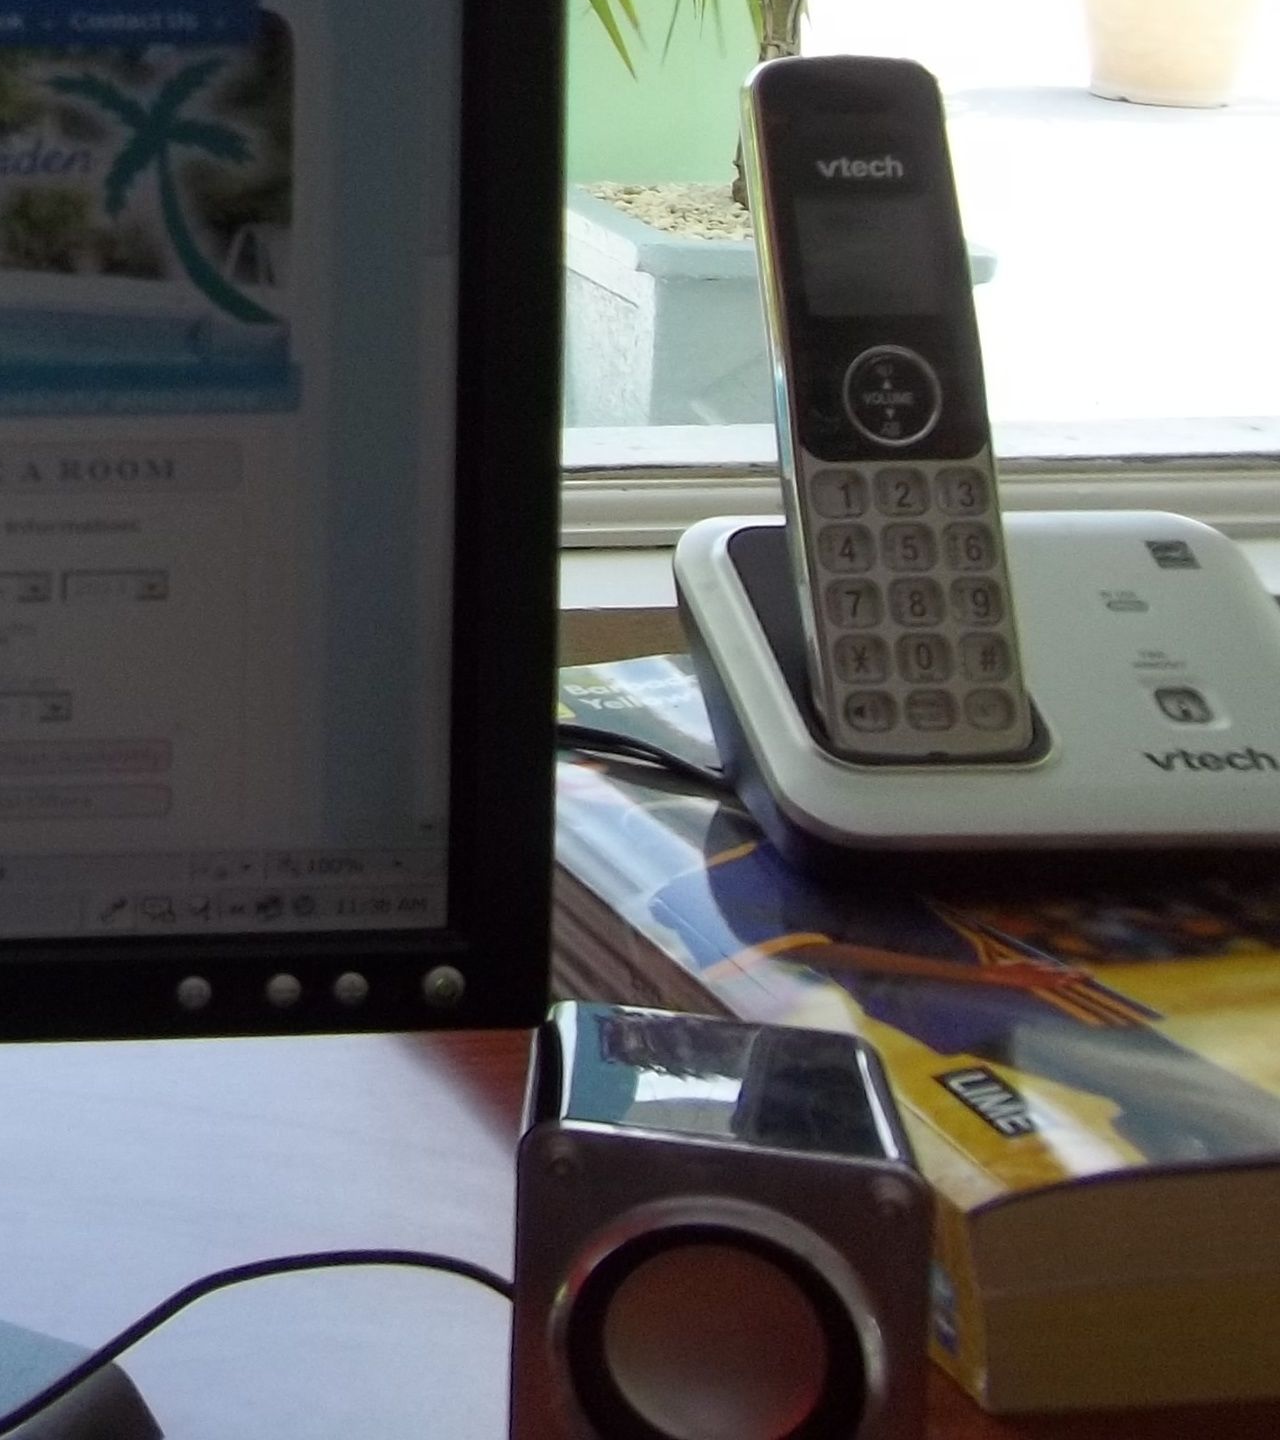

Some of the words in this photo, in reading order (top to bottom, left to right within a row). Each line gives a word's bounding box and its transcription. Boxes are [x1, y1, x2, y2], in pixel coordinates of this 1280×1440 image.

[816, 153, 906, 180] vtech
[861, 391, 915, 408] VOLUME
[20, 459, 44, 483] A
[58, 457, 176, 482] ROOM
[838, 482, 853, 509] 1
[893, 482, 912, 509] 2
[958, 481, 976, 508] 3
[838, 536, 856, 563] 4
[901, 535, 919, 562] 5
[965, 535, 983, 562] 6
[844, 590, 863, 619] 7
[908, 590, 927, 618] 8
[971, 588, 990, 617] 9
[914, 642, 933, 671] 0
[980, 645, 998, 672] #
[1145, 744, 1279, 771] vtech
[944, 1069, 1036, 1136] LIME
